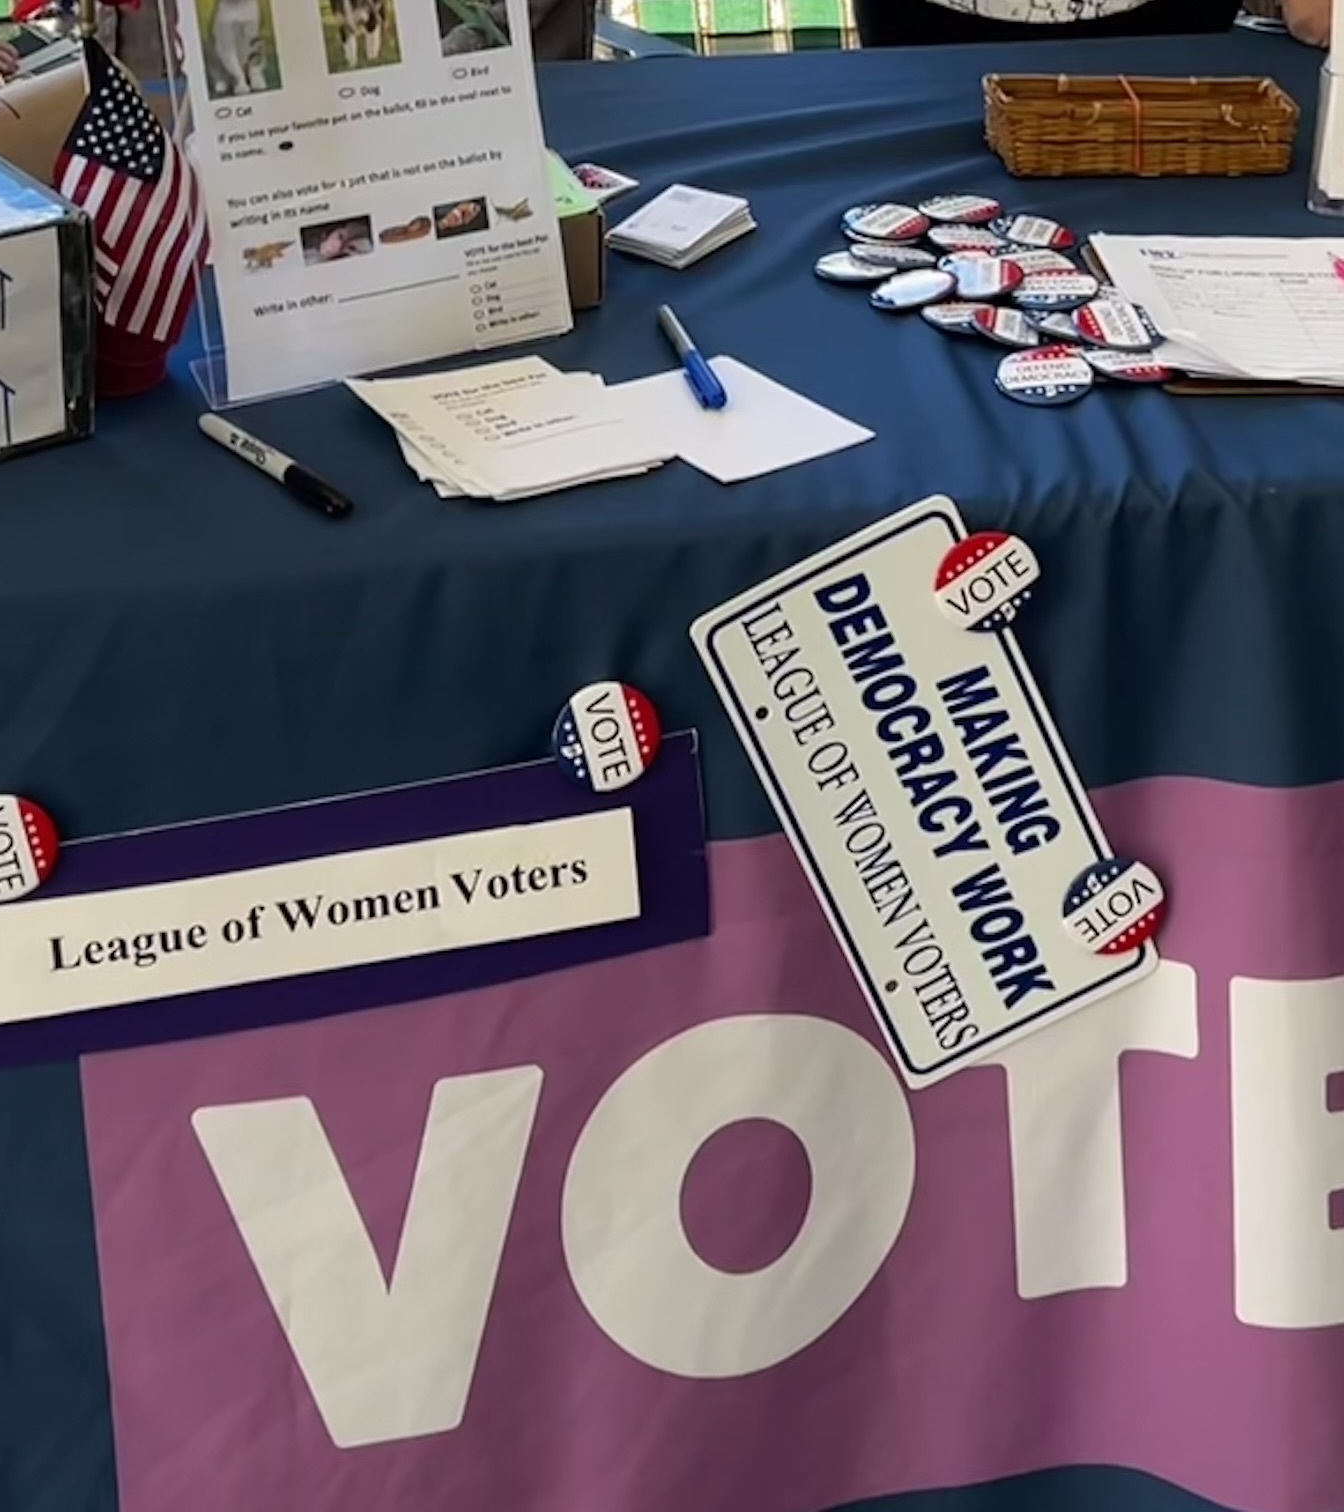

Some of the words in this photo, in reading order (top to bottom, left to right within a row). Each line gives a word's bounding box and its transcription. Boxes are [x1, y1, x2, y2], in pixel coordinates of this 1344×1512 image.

[359, 86, 380, 99] Dog
[470, 65, 490, 78] Bird
[228, 132, 247, 144] you
[268, 124, 290, 138] your
[291, 115, 330, 132] favorite
[332, 114, 348, 126] pet
[364, 106, 381, 118] the
[430, 96, 439, 106] in
[440, 94, 456, 105] the
[458, 91, 477, 103] oval
[479, 87, 500, 99] next
[501, 85, 513, 95] to
[235, 104, 253, 118] Cat
[227, 197, 248, 210] You
[249, 194, 269, 204] can
[271, 187, 293, 201] also
[295, 183, 319, 197] vote
[321, 179, 338, 191] for
[368, 170, 390, 183] that
[392, 167, 401, 178] is
[403, 165, 422, 177] not
[423, 162, 436, 172] on
[438, 157, 456, 170] the
[458, 152, 488, 167] ballot
[489, 149, 503, 163] by
[230, 213, 269, 229] writing
[271, 210, 281, 220] in
[283, 207, 298, 218] its
[299, 201, 331, 214] name
[254, 299, 285, 318] Write
[286, 298, 297, 309] in
[299, 292, 334, 308] other:
[1016, 363, 1072, 372] DEFEND
[945, 549, 1032, 618] VOTE
[740, 601, 827, 748] LEAGUE
[583, 690, 632, 783] VOTE
[807, 741, 860, 796] OF
[934, 663, 1062, 857] MAKING
[813, 572, 992, 859] DEMOCRACY
[948, 862, 1058, 1010] WORK
[832, 790, 922, 930] WOMEN
[47, 922, 209, 976] League
[220, 905, 266, 945] of
[275, 884, 441, 934] Women
[448, 854, 590, 907] Voters
[1073, 876, 1158, 944] VOTE
[895, 918, 981, 1052] VOTERS
